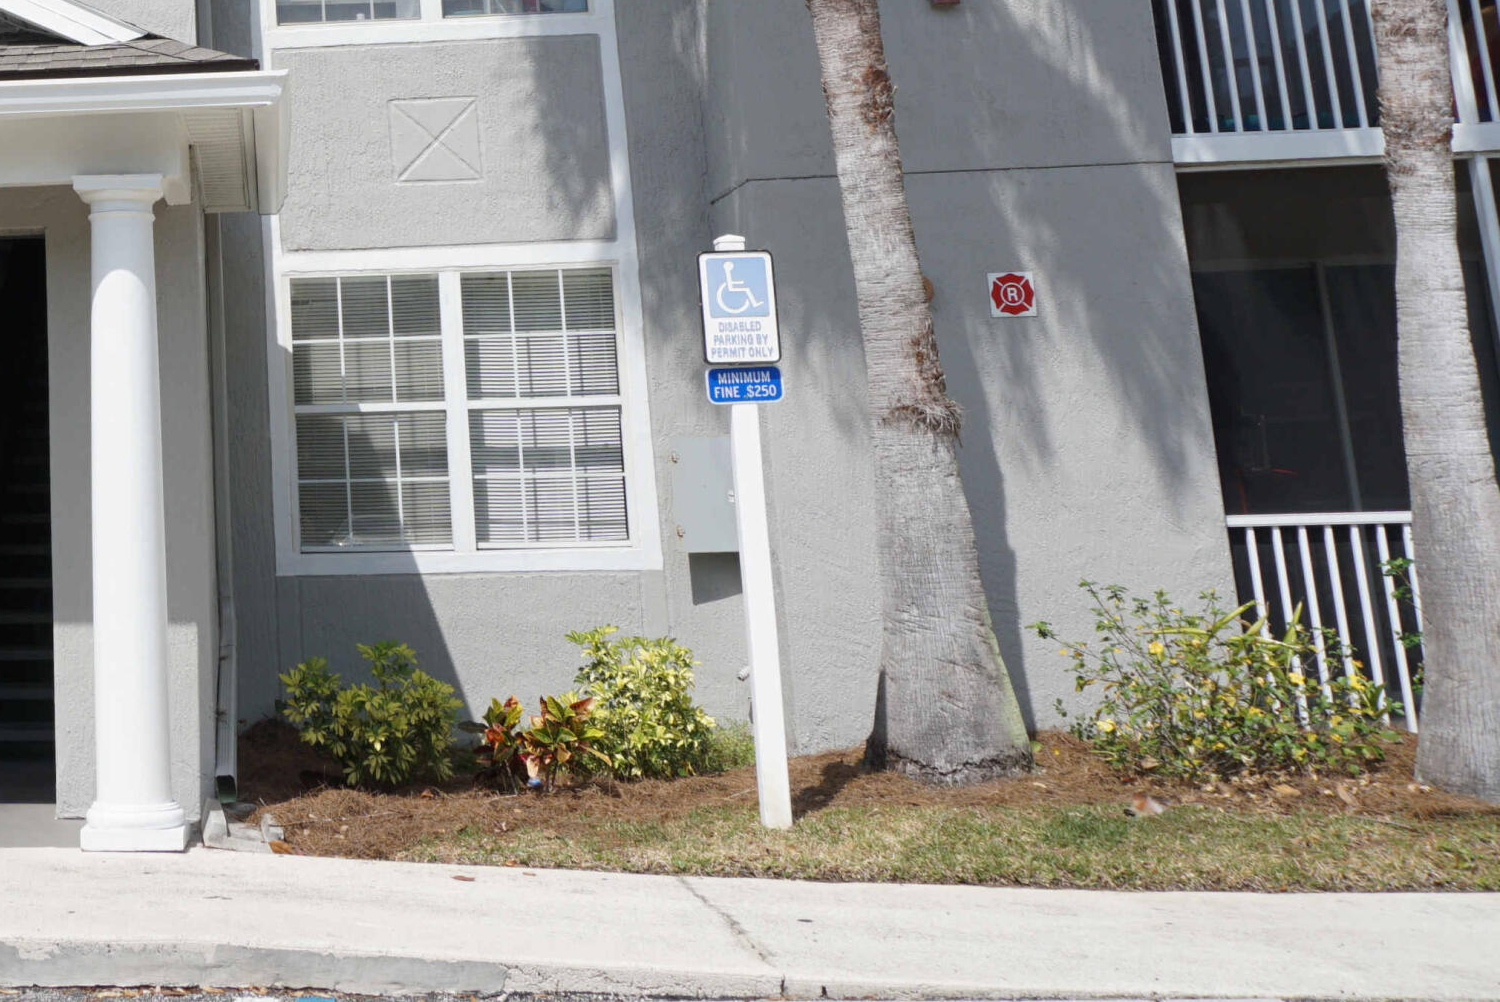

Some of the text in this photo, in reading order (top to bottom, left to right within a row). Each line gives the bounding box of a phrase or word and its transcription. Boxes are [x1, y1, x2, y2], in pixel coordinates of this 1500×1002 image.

[1007, 287, 1018, 301] R
[718, 321, 762, 333] DISABLED
[713, 333, 769, 346] PARKING BY
[711, 346, 774, 359] PERMIT ONLY
[718, 371, 771, 385] MINIMUM
[714, 384, 777, 399] FINE $250
